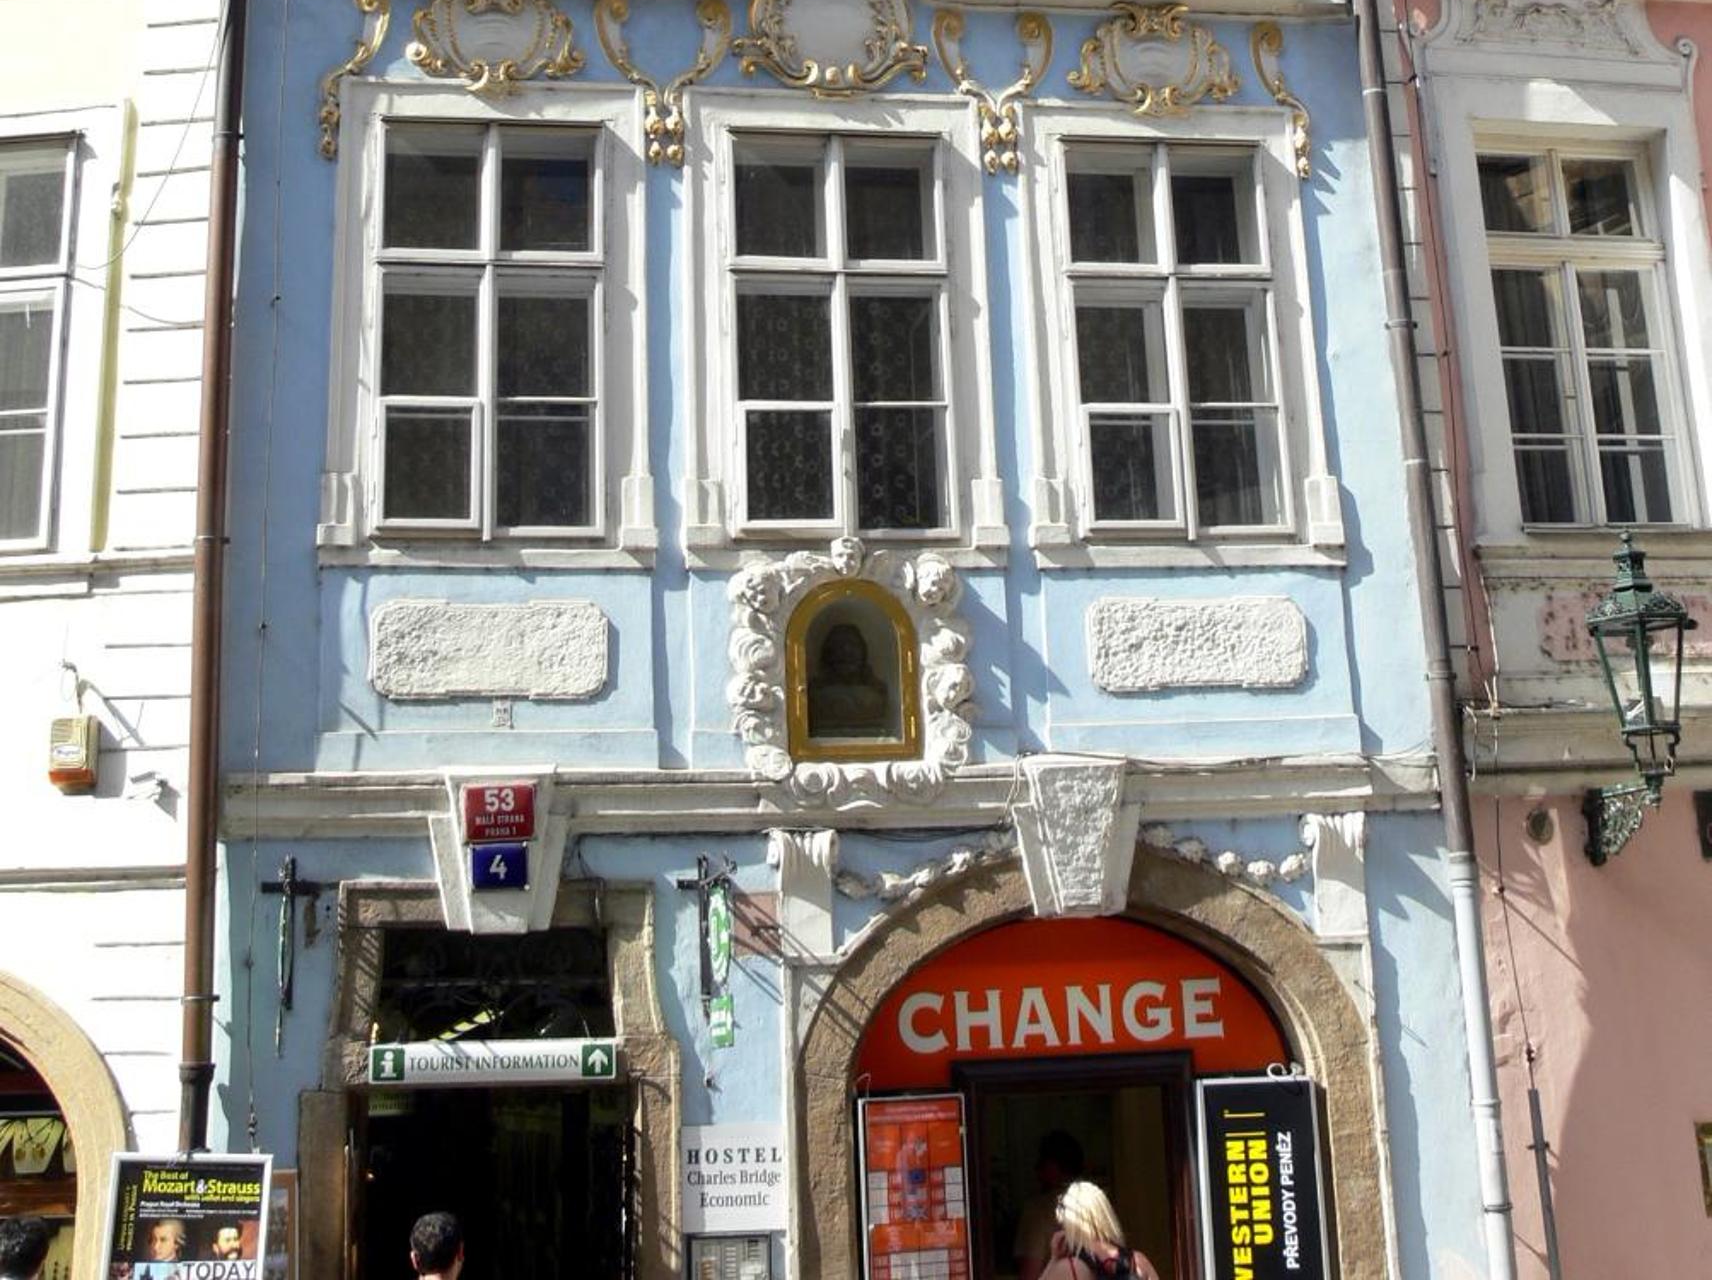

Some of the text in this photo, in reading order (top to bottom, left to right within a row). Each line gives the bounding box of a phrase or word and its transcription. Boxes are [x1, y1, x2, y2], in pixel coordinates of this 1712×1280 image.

[484, 788, 515, 812] 53
[489, 854, 507, 880] 4
[898, 977, 1225, 1054] CHANGE
[410, 1056, 472, 1071] TOURIST
[476, 1054, 580, 1070] INFORMATION
[687, 1147, 783, 1165] HOSTEL
[143, 1171, 189, 1180] The Best of
[687, 1170, 782, 1188] Charles Bridge
[700, 1191, 771, 1208] Economic
[1248, 1139, 1274, 1245] UNION
[1281, 1189, 1300, 1270] PŘEVODY
[183, 1262, 255, 1280] TODAY
